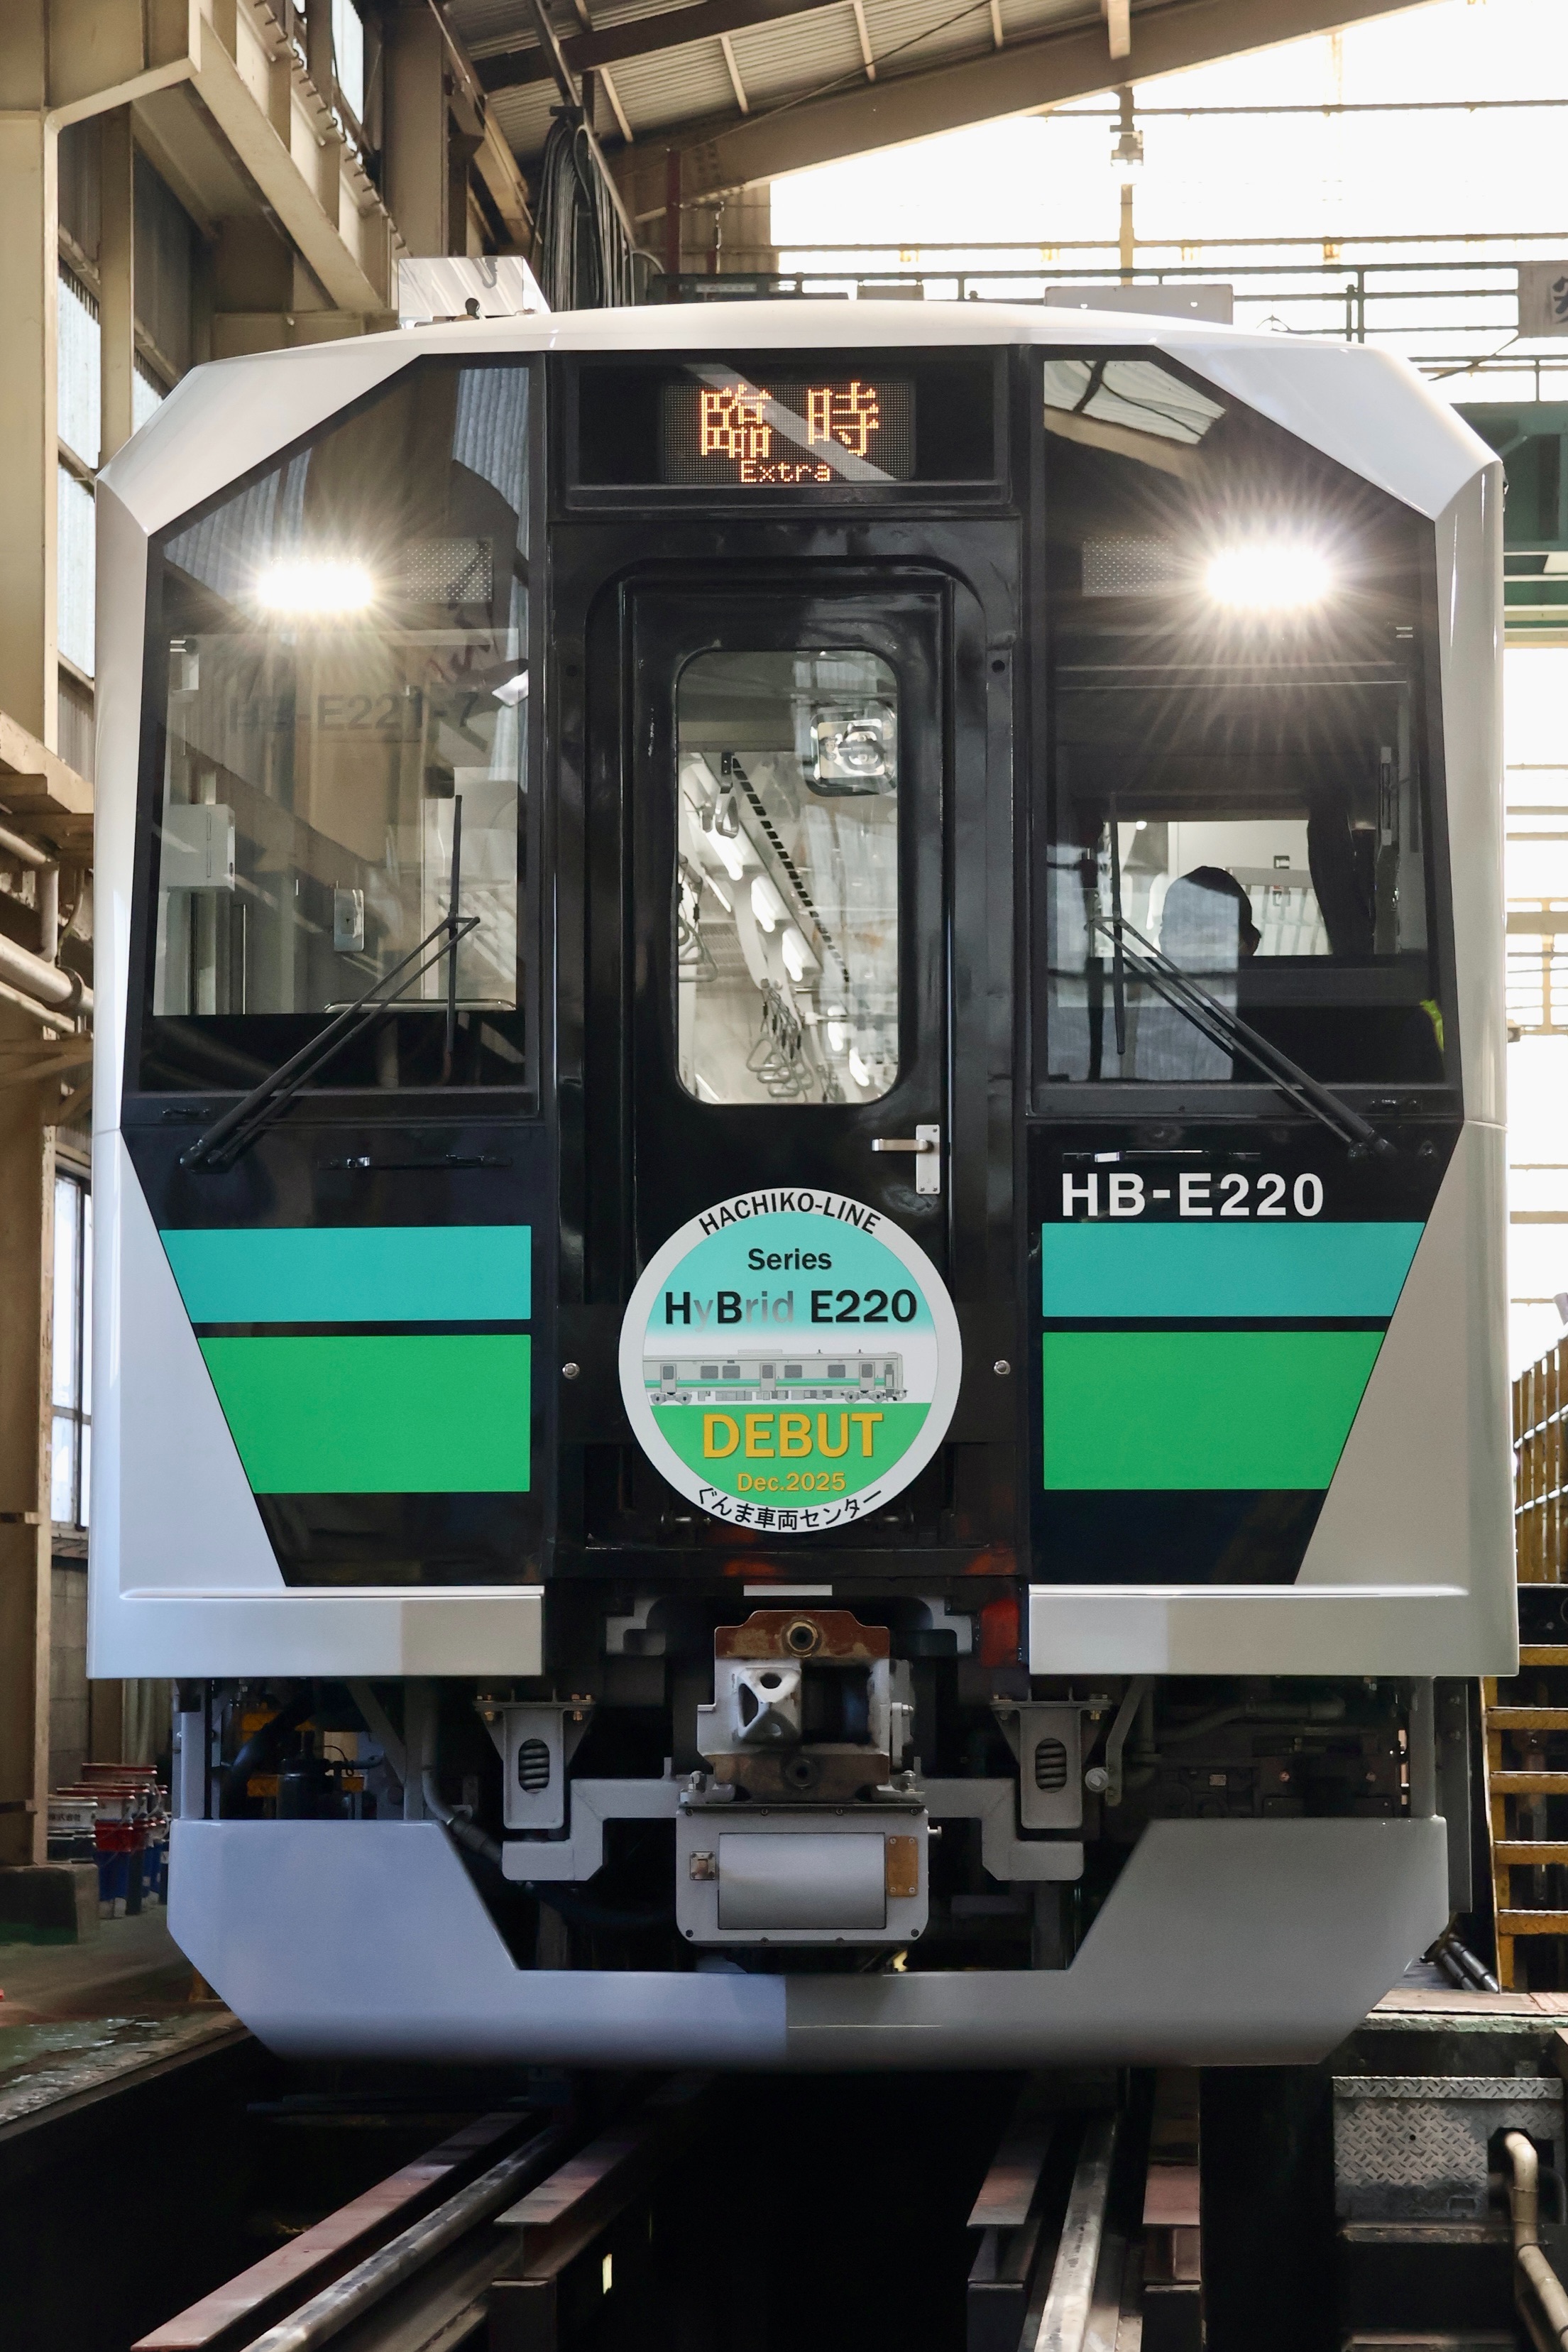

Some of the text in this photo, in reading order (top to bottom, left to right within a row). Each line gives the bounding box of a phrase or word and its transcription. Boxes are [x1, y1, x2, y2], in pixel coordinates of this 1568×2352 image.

[741, 460, 830, 482] Extra
[698, 1191, 881, 1235] HACHIKO-LINE
[1063, 1173, 1323, 1216] HB-E220
[747, 1248, 832, 1271] Series
[665, 1289, 917, 1333] HyBrid E220
[703, 1413, 883, 1458] DEBUT
[738, 1472, 845, 1492] Dec.2025
[698, 1488, 882, 1530] ぐんま車両センター
